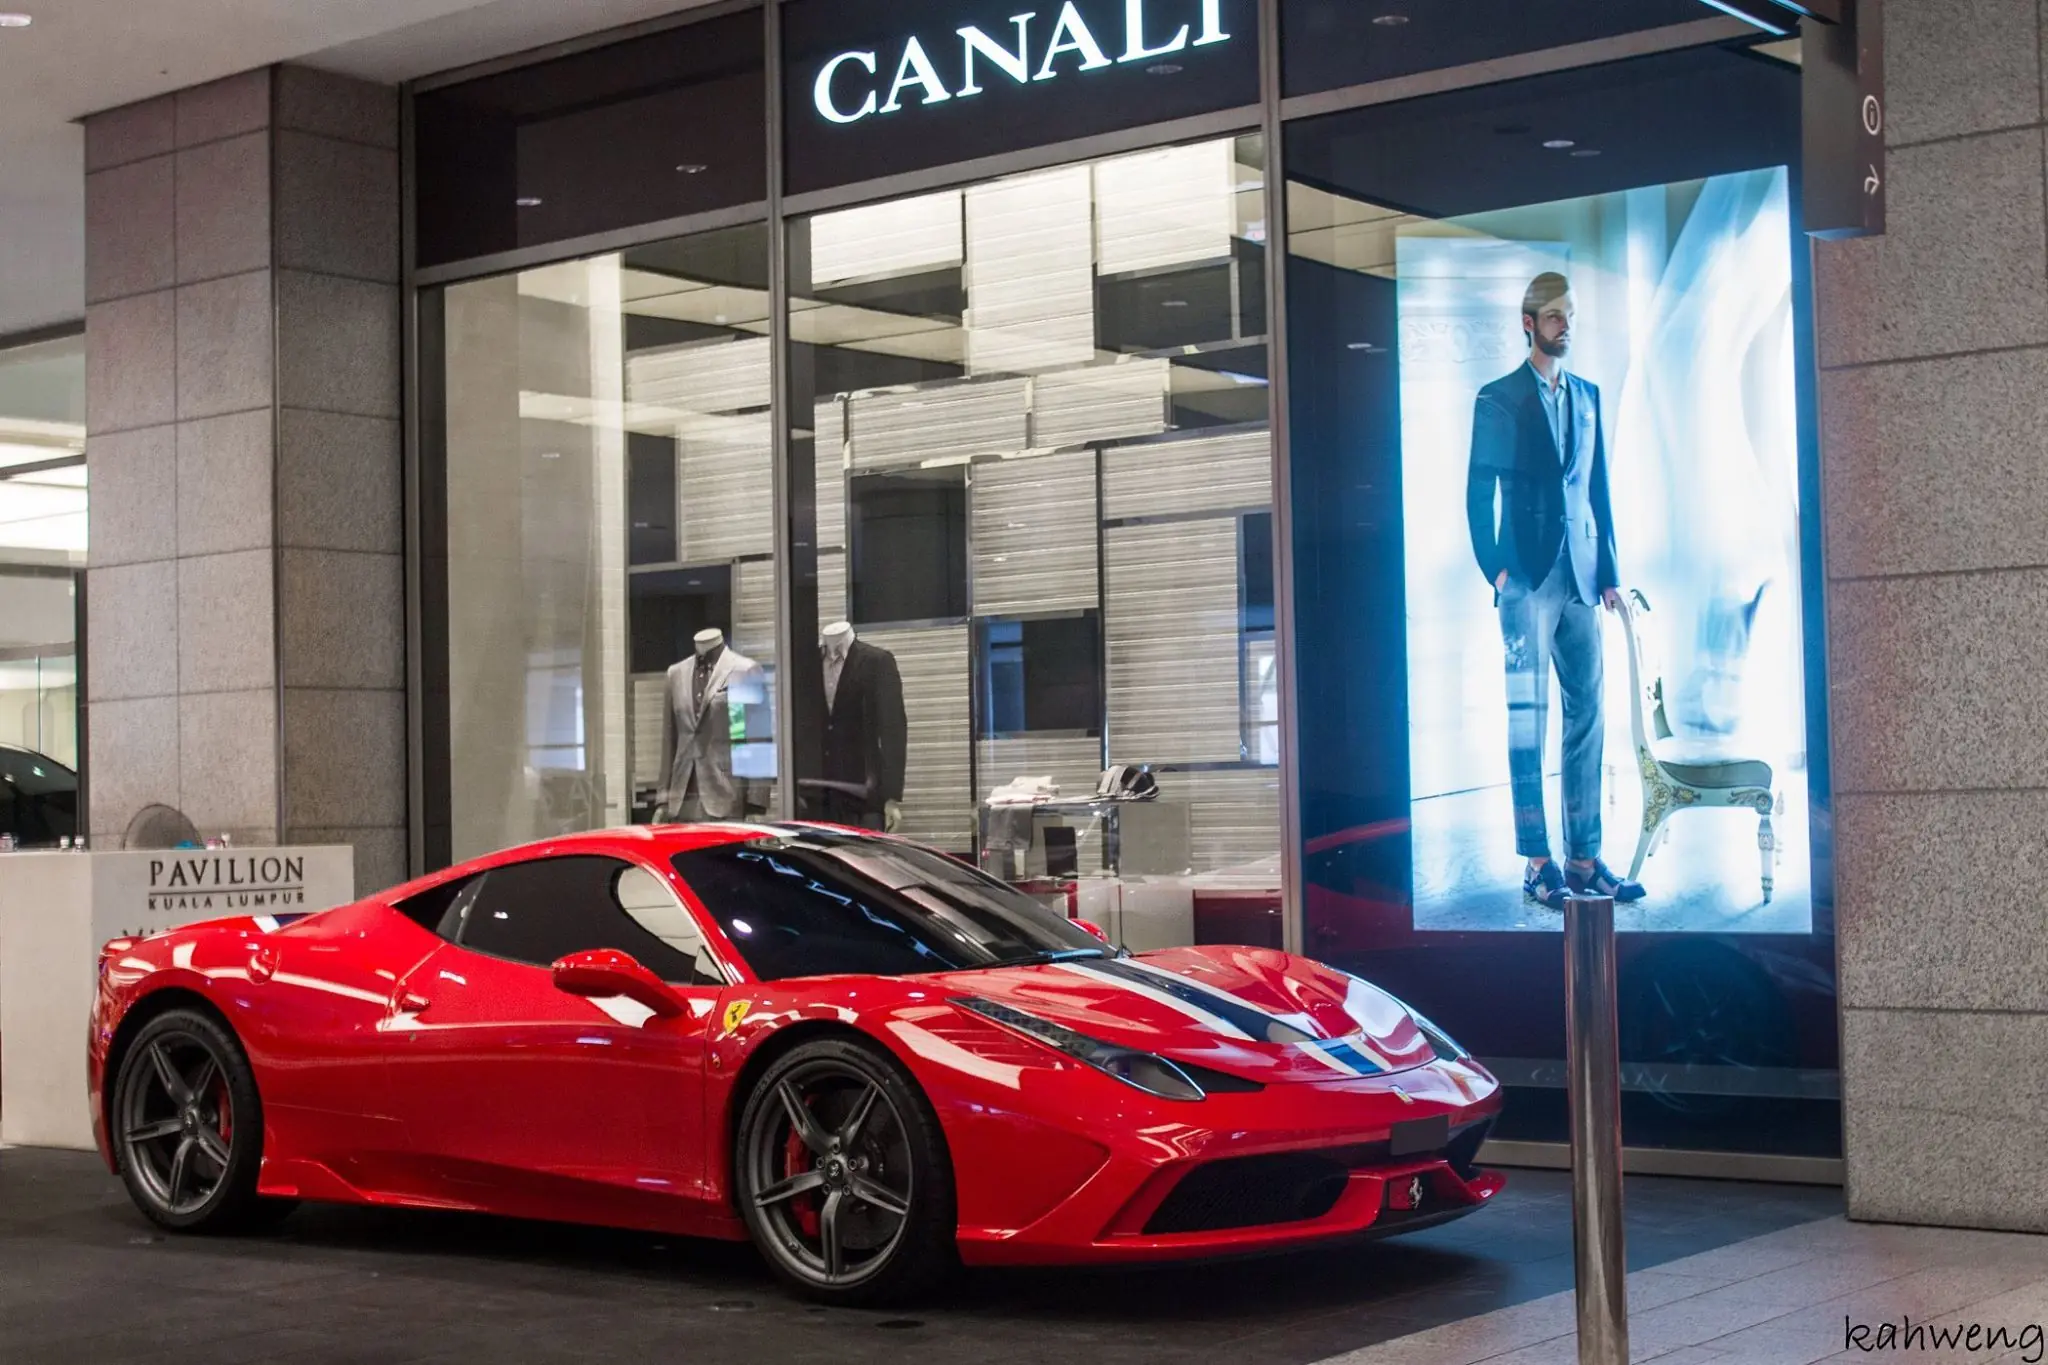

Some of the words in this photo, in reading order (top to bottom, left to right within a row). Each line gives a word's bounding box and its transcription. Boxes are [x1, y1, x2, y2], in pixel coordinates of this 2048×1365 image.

[813, 0, 1232, 124] CANALI
[149, 856, 304, 887] PAVILION
[148, 895, 213, 911] KUALA
[226, 892, 305, 908] LUMPUR
